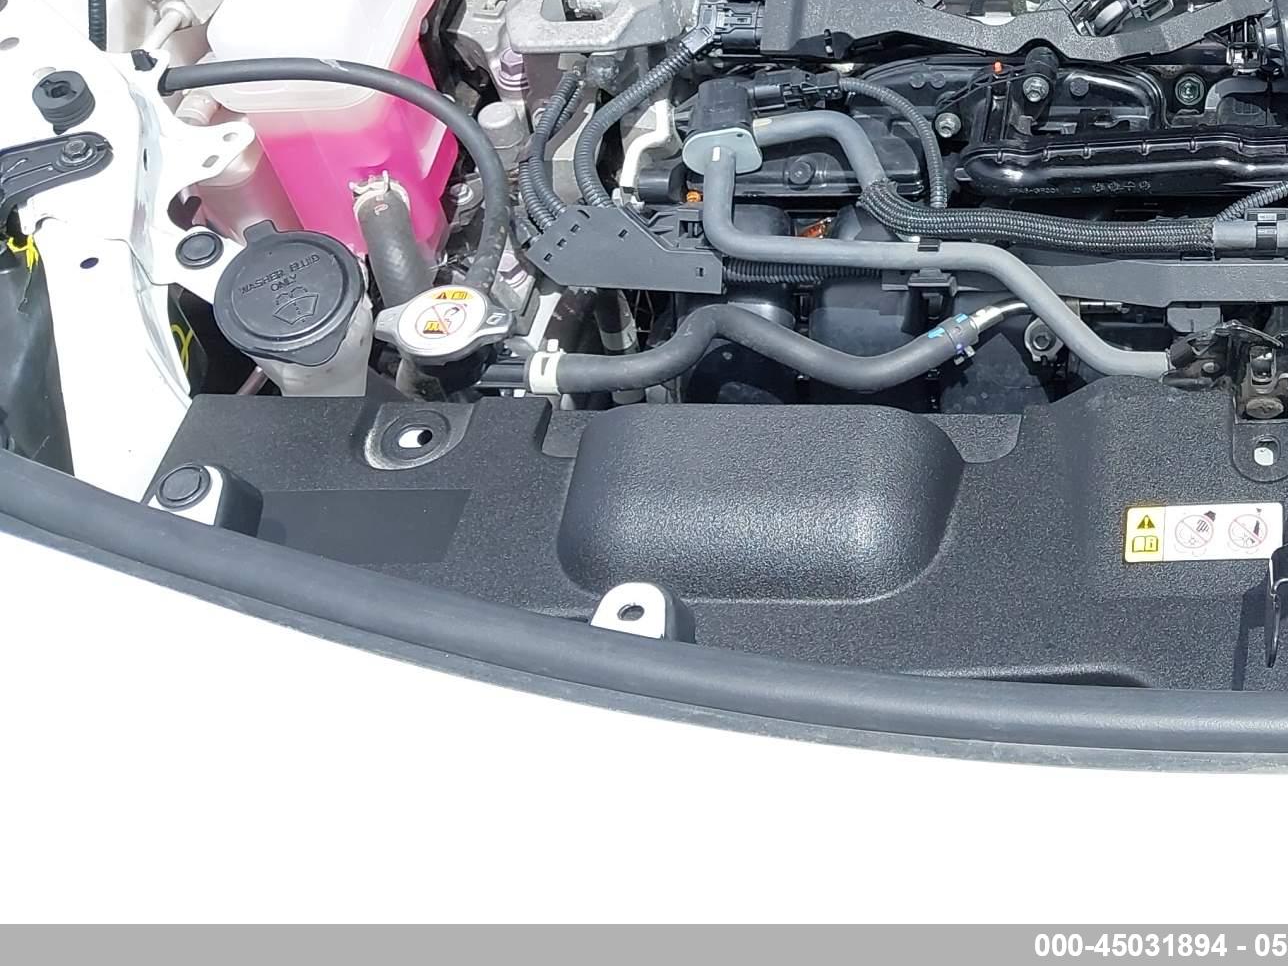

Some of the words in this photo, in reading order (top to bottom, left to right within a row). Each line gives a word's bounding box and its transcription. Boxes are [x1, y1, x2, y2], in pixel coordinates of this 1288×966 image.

[240, 269, 284, 294] WASHER
[289, 254, 320, 272] FLUID
[270, 274, 297, 291] ONLY
